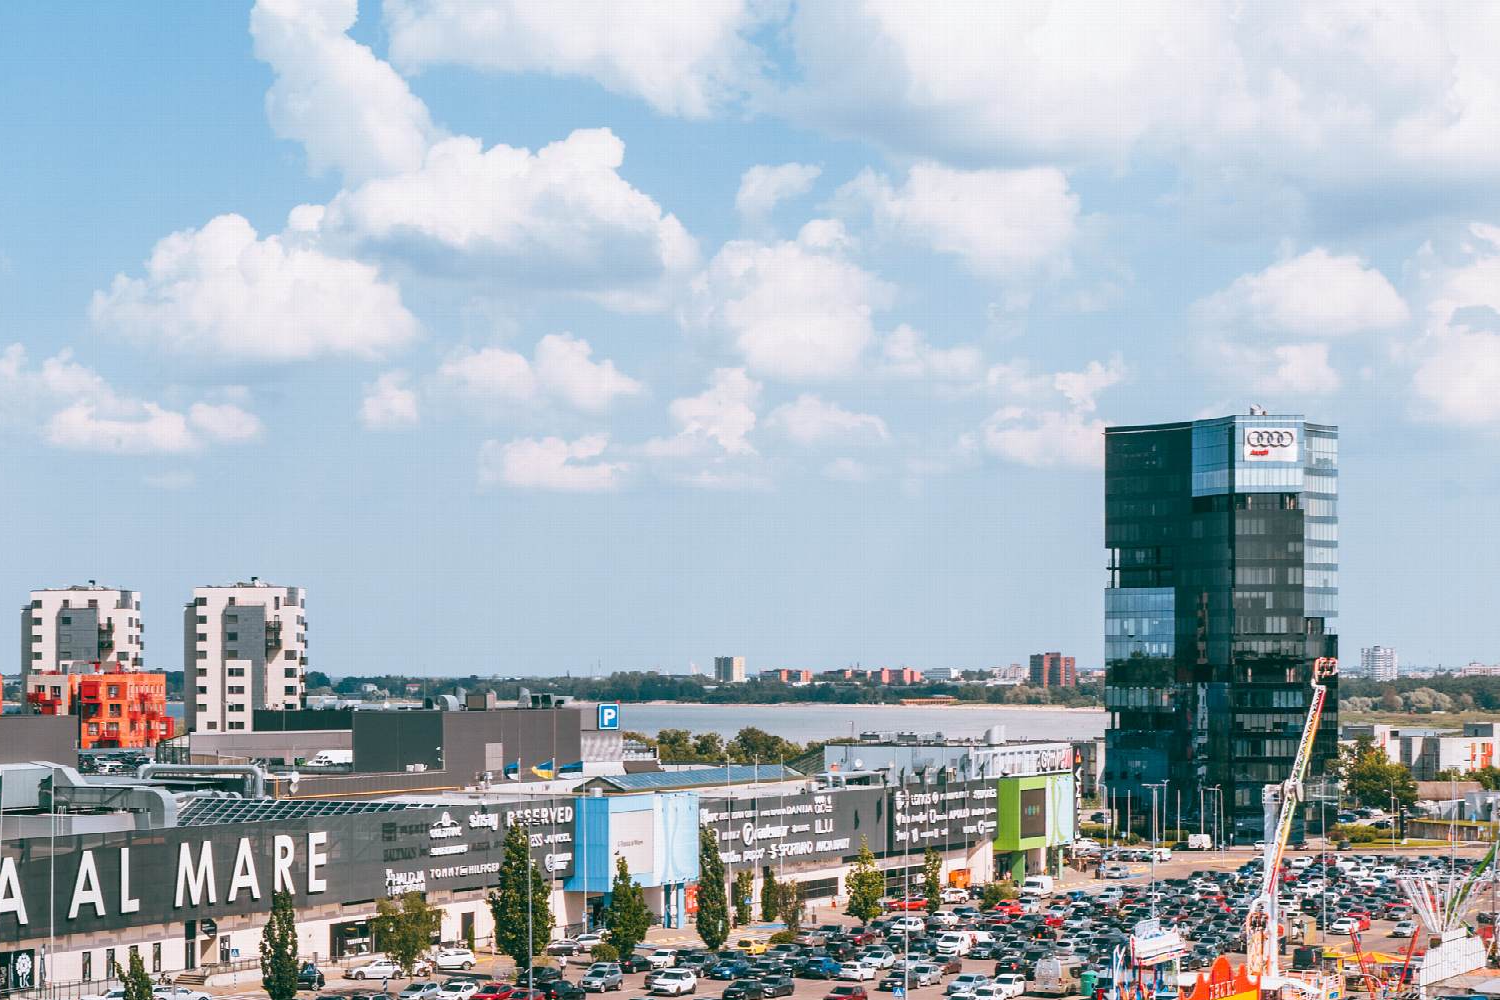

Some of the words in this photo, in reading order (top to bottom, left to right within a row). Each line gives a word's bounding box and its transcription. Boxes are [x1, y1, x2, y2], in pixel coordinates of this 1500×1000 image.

[604, 709, 616, 726] P
[507, 806, 573, 827] RESERVED
[69, 847, 139, 919] AL
[174, 831, 328, 907] MARE
[429, 867, 460, 879] TOMMY
[468, 862, 500, 875] HILFIGER
